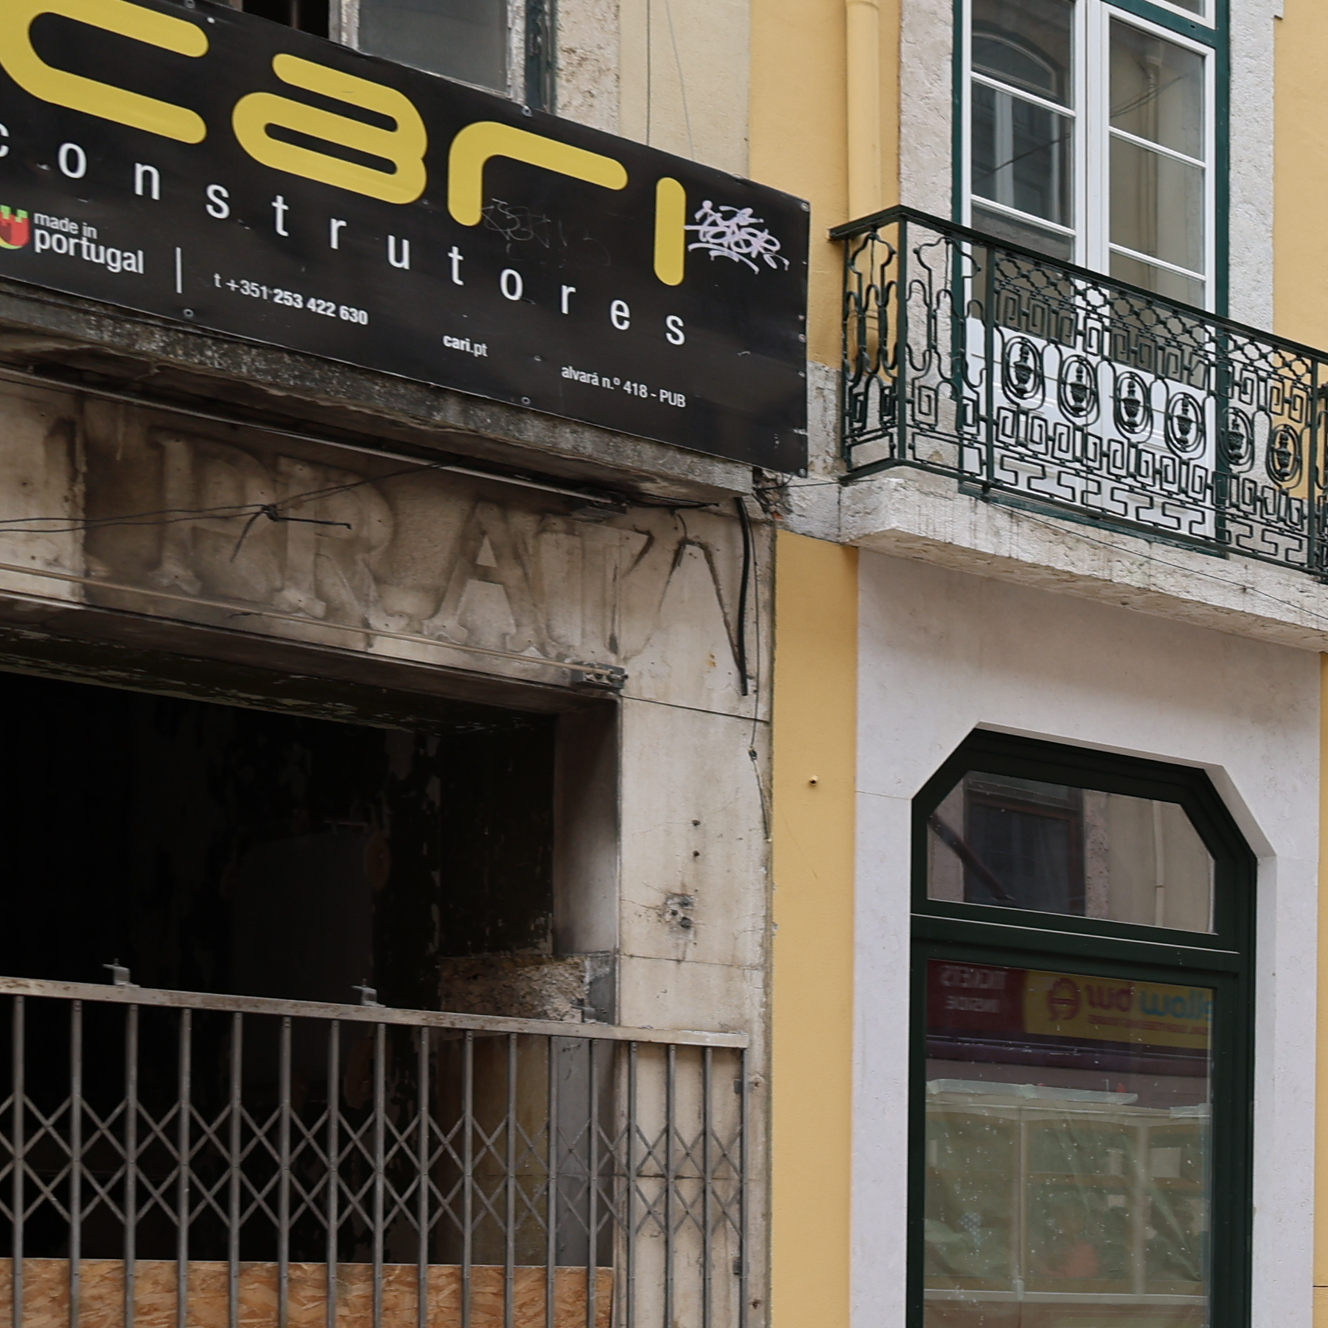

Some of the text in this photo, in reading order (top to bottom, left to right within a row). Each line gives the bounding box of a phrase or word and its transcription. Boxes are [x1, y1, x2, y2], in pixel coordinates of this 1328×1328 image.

[0, 0, 686, 286] cari
[34, 212, 98, 240] made in
[34, 228, 144, 275] portugal
[213, 273, 369, 326] t +351 253 422 630
[442, 334, 488, 358] cari.pt
[561, 364, 600, 386] alvará
[623, 380, 648, 398] 418
[659, 388, 686, 408] PUB
